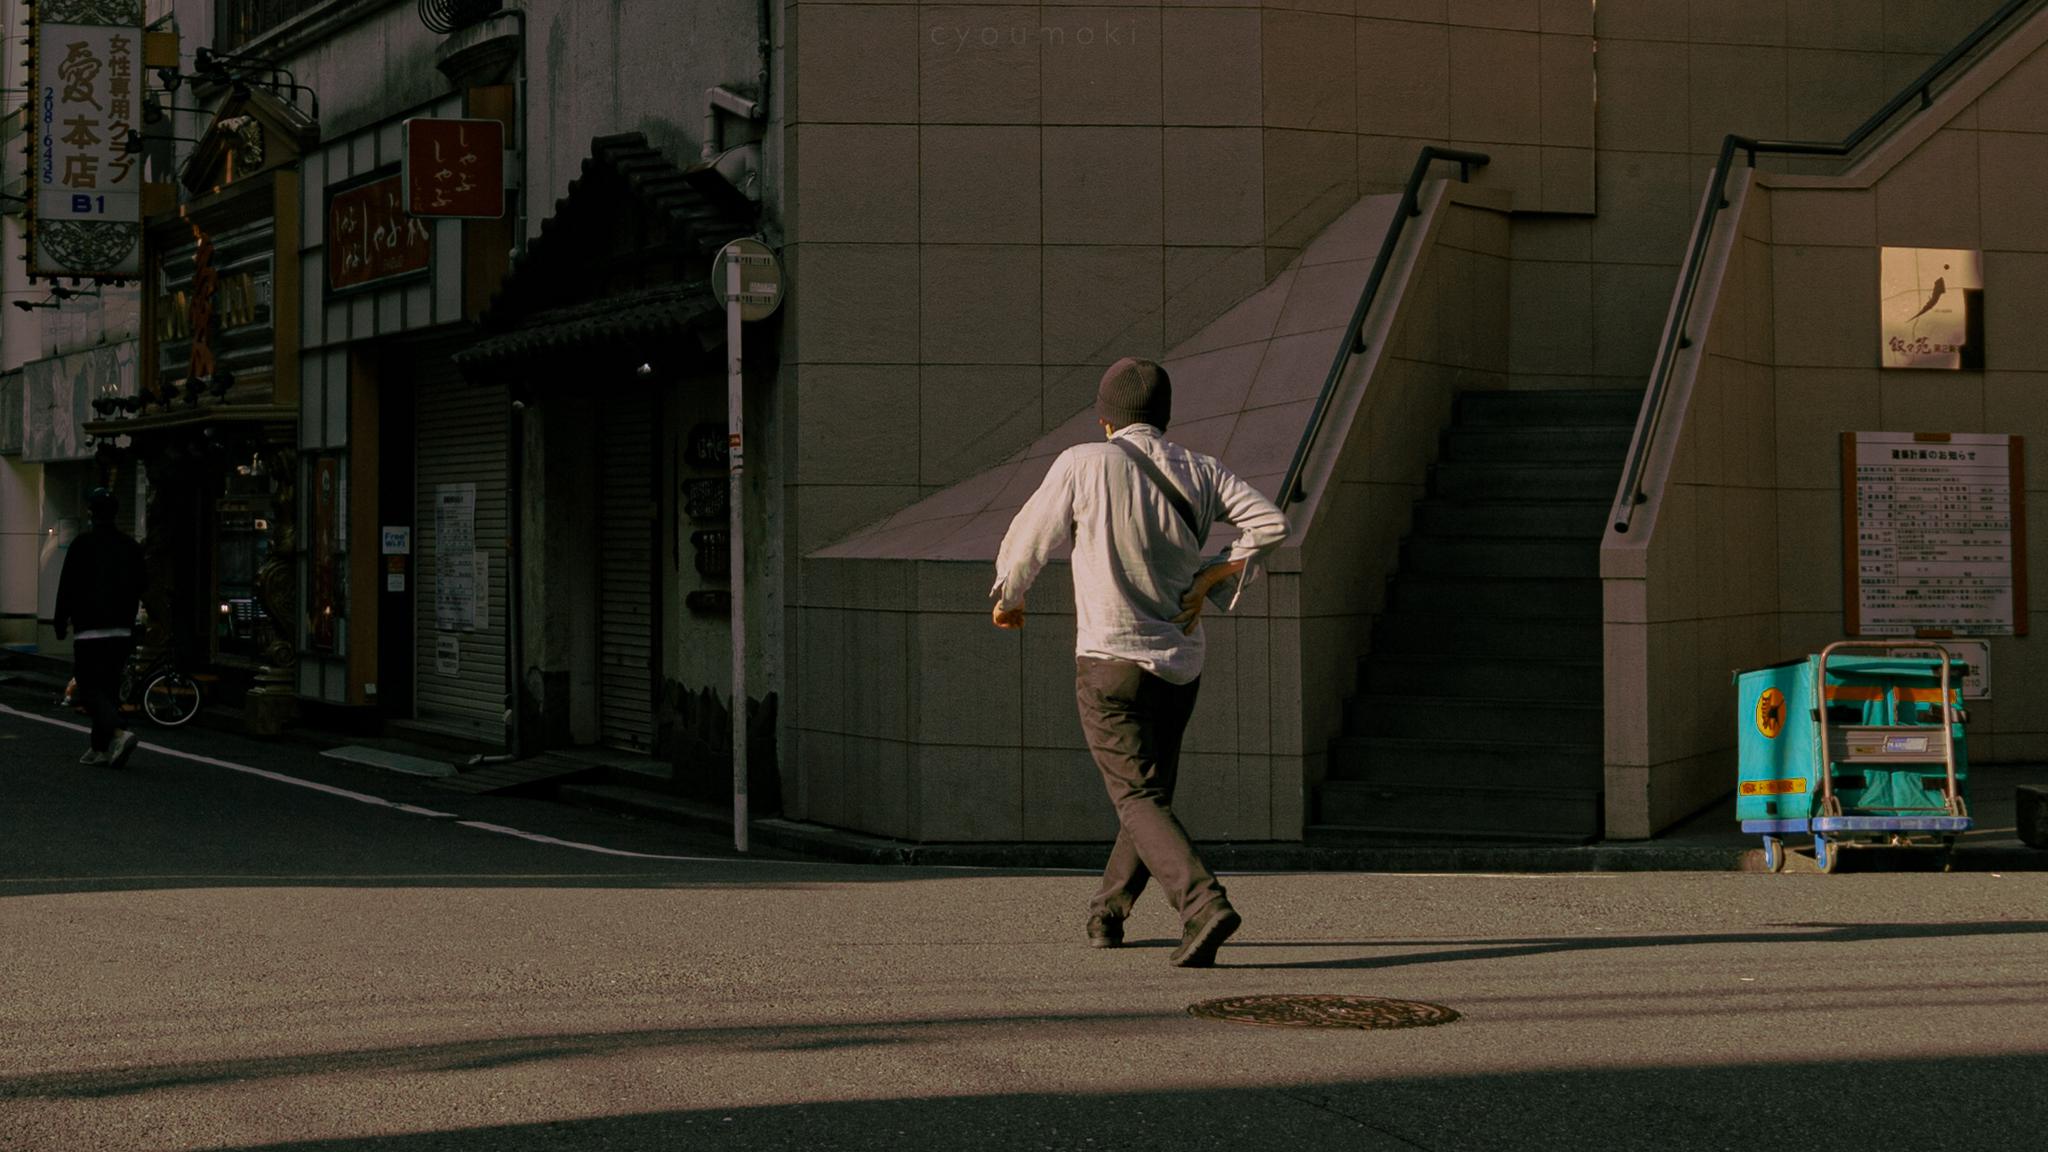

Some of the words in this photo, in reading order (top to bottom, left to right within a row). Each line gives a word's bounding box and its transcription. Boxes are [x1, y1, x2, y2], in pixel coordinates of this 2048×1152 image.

[58, 41, 104, 189] 愛本店
[108, 33, 136, 184] 女性専用クラブ
[71, 194, 105, 214] B1
[1891, 449, 1976, 461] 建築計画のお知らせ
